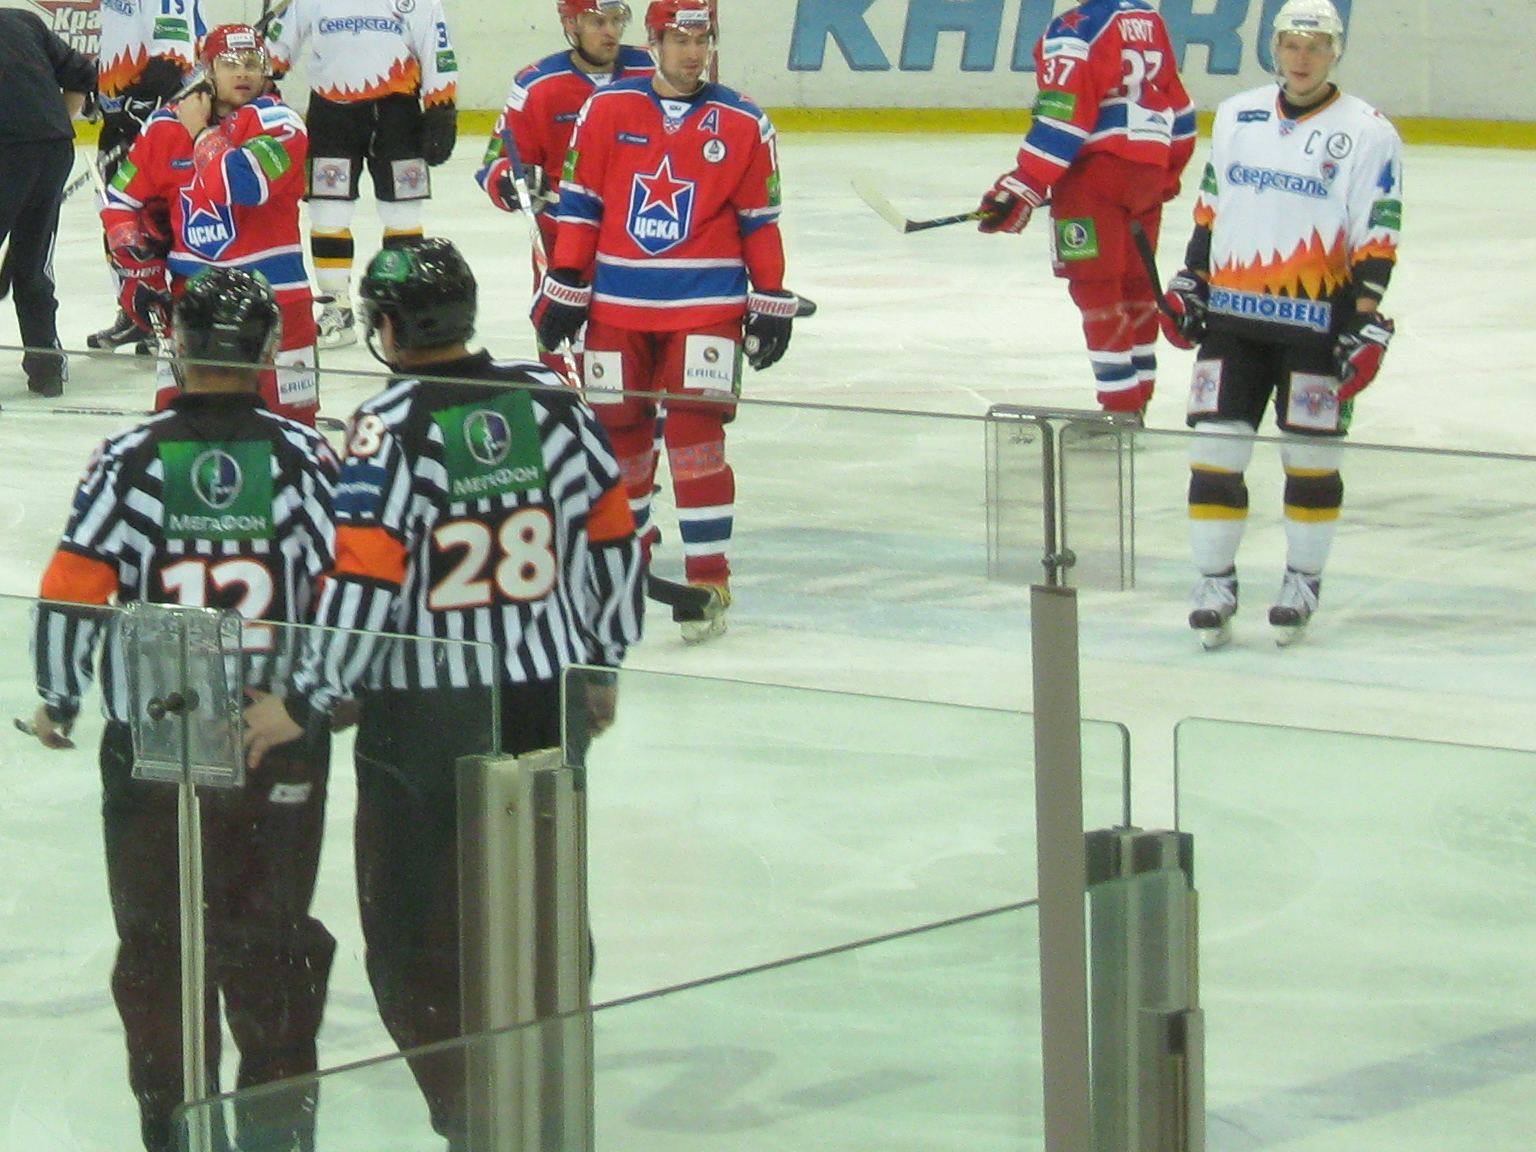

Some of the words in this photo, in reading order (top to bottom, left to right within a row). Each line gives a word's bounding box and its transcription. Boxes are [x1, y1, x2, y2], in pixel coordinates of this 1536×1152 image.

[54, 6, 102, 34] Кра
[1042, 58, 1076, 87] 37
[697, 108, 720, 135] A
[187, 223, 229, 247] ЦСКА
[634, 215, 680, 241] ЦСКА
[428, 506, 556, 611] 28
[160, 558, 276, 651] 12
